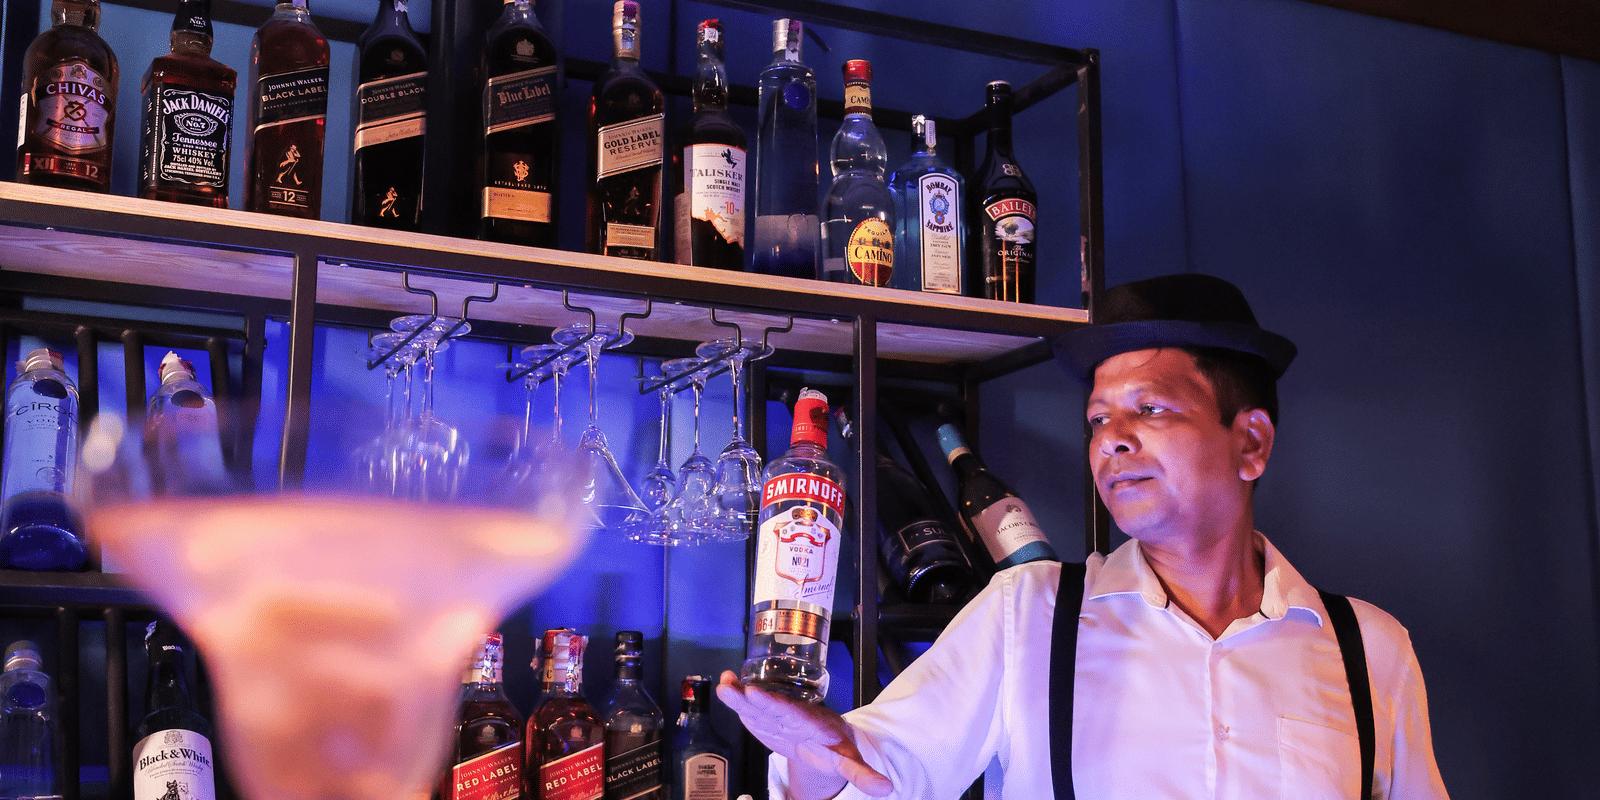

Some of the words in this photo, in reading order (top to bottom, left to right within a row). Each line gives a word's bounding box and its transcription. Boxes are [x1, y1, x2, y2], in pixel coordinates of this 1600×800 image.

[46, 82, 106, 105] CHIVAS
[261, 90, 296, 102] BLACK
[297, 85, 328, 96] LABEL
[268, 81, 297, 92] JOHNNIE
[361, 92, 396, 104] DOUBLE
[397, 86, 426, 97] BLACK
[496, 91, 523, 106] Blue
[521, 83, 551, 100] Label
[162, 97, 191, 115] JACK
[60, 123, 87, 133] REGAL
[172, 132, 218, 148] Tennessee
[603, 137, 630, 149] GOLD
[630, 130, 661, 143] LABEL
[172, 146, 216, 160] WHISKEY
[609, 139, 659, 156] RESERVE
[172, 154, 187, 163] 75cl
[187, 156, 202, 166] 40%
[85, 164, 98, 178] 12
[690, 168, 743, 181] TALISKER
[925, 181, 953, 195] BOMBAY
[283, 190, 296, 203] 12
[725, 201, 735, 215] 10
[925, 219, 955, 233] SAPPHIRE
[997, 249, 1033, 259] ORIGINAL
[789, 546, 814, 555] VODKA
[139, 750, 169, 771] Black
[169, 749, 181, 759] &
[456, 777, 480, 792] RED
[482, 763, 518, 782] LABEL
[460, 766, 486, 780] JOHNNIE
[545, 777, 567, 791] RED
[569, 763, 603, 781] LABEL
[549, 765, 574, 778] JOHNNIE
[605, 768, 634, 783] BLACK
[635, 758, 662, 772] LABEL
